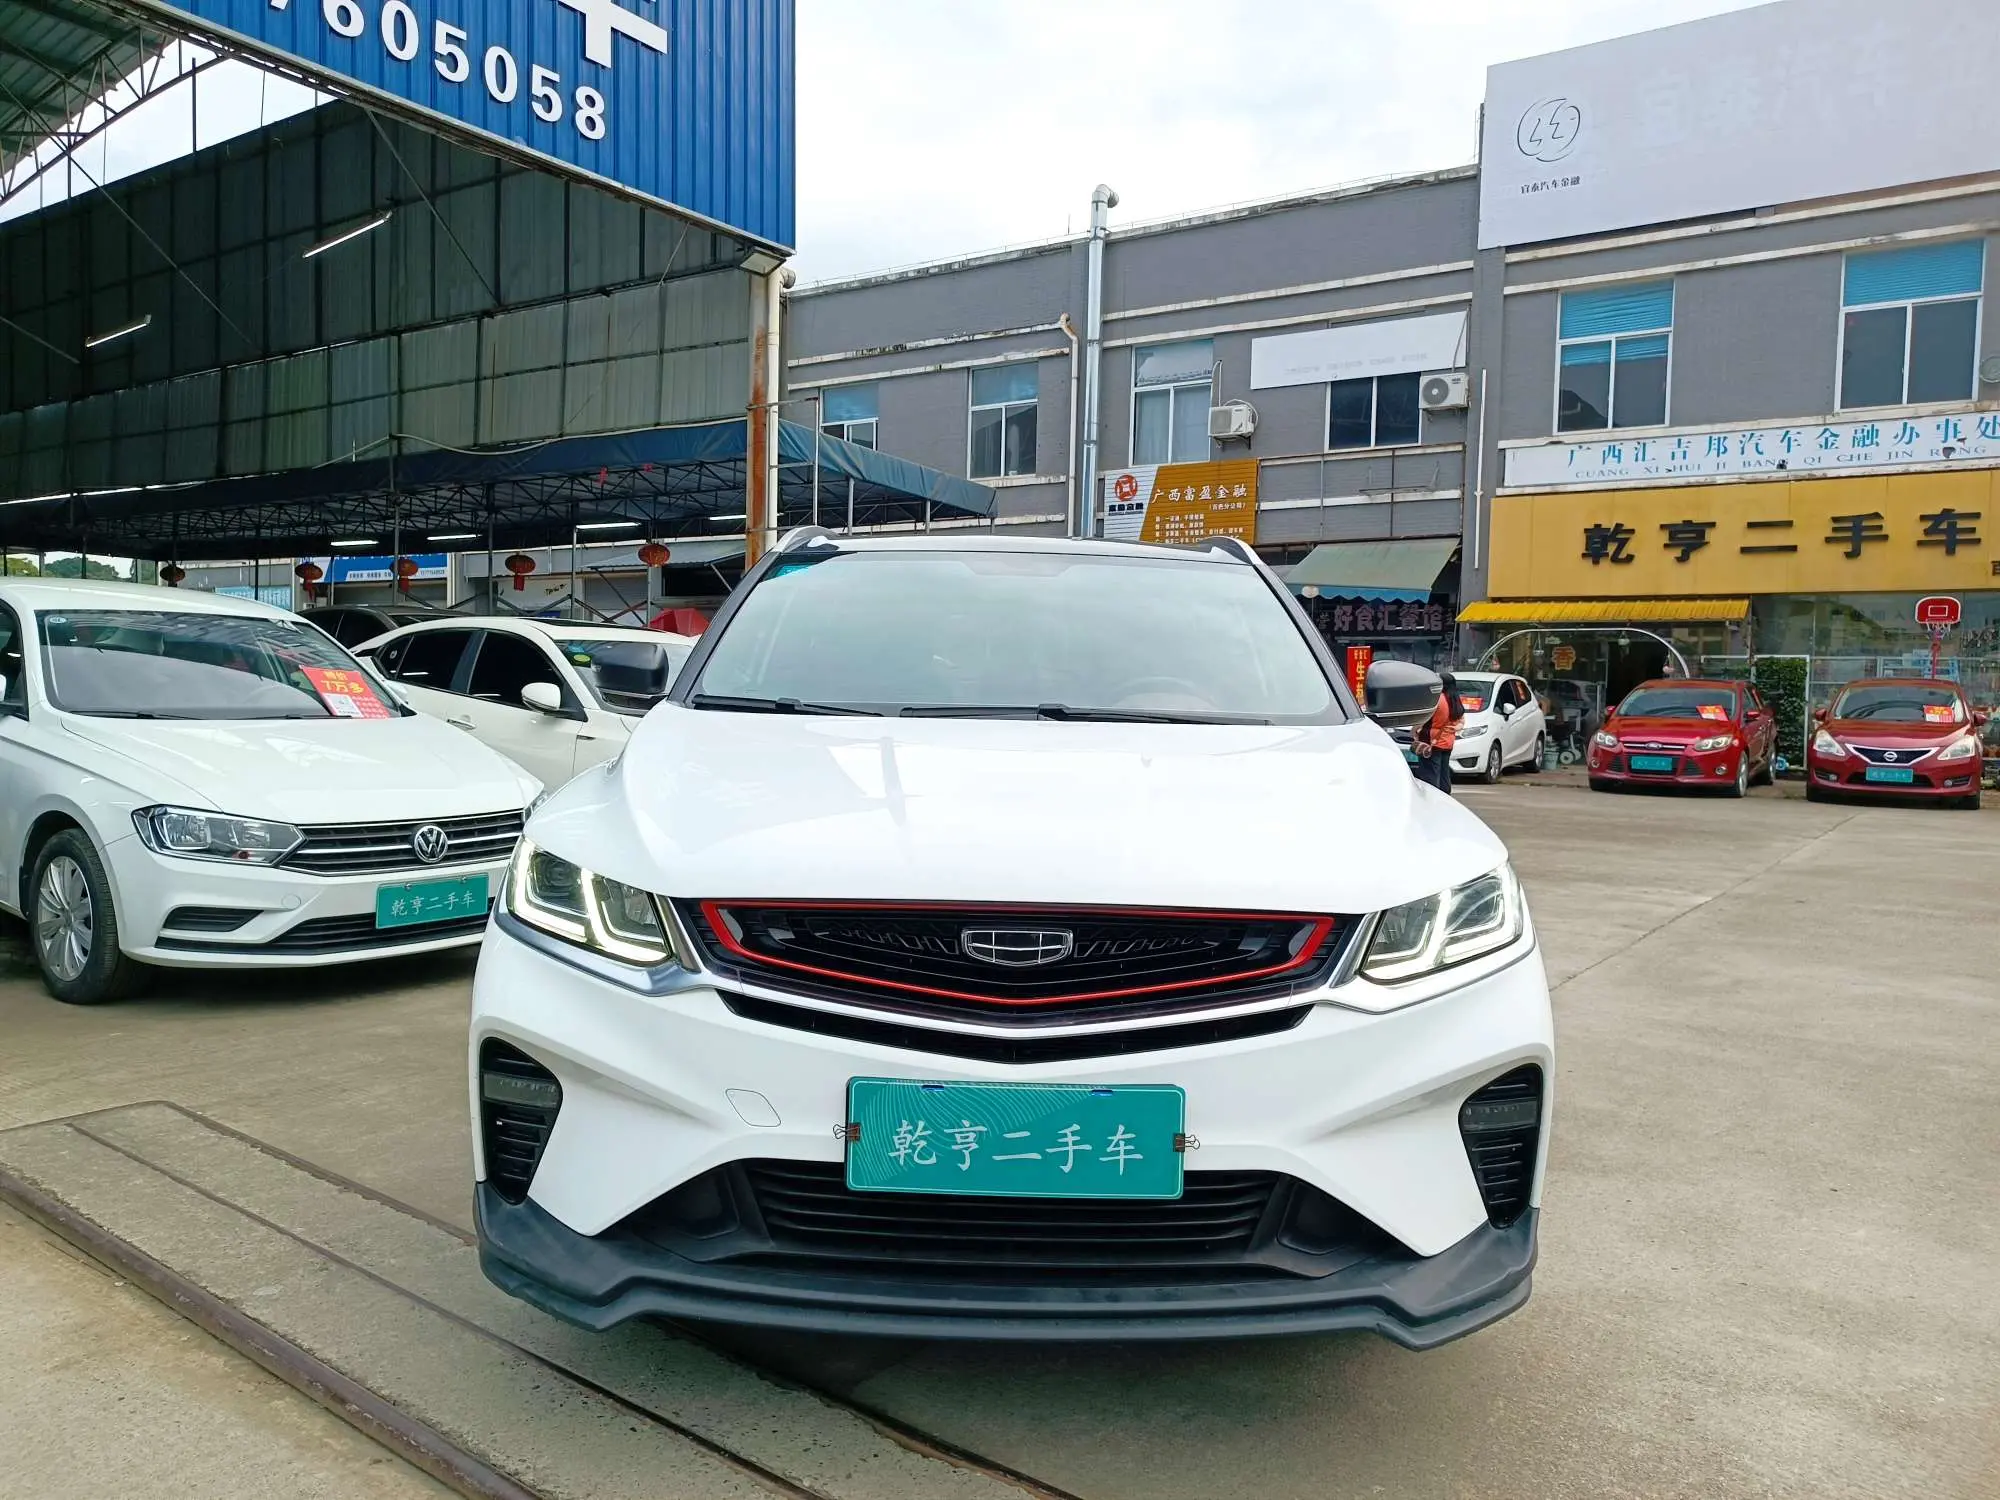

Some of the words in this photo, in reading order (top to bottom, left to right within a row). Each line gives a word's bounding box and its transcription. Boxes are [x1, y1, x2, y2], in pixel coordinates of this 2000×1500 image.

[1581, 508, 1982, 565] 乾亨二手车
[391, 890, 476, 917] 乾亨二手车
[887, 1119, 1144, 1175] 乾亨二手车
